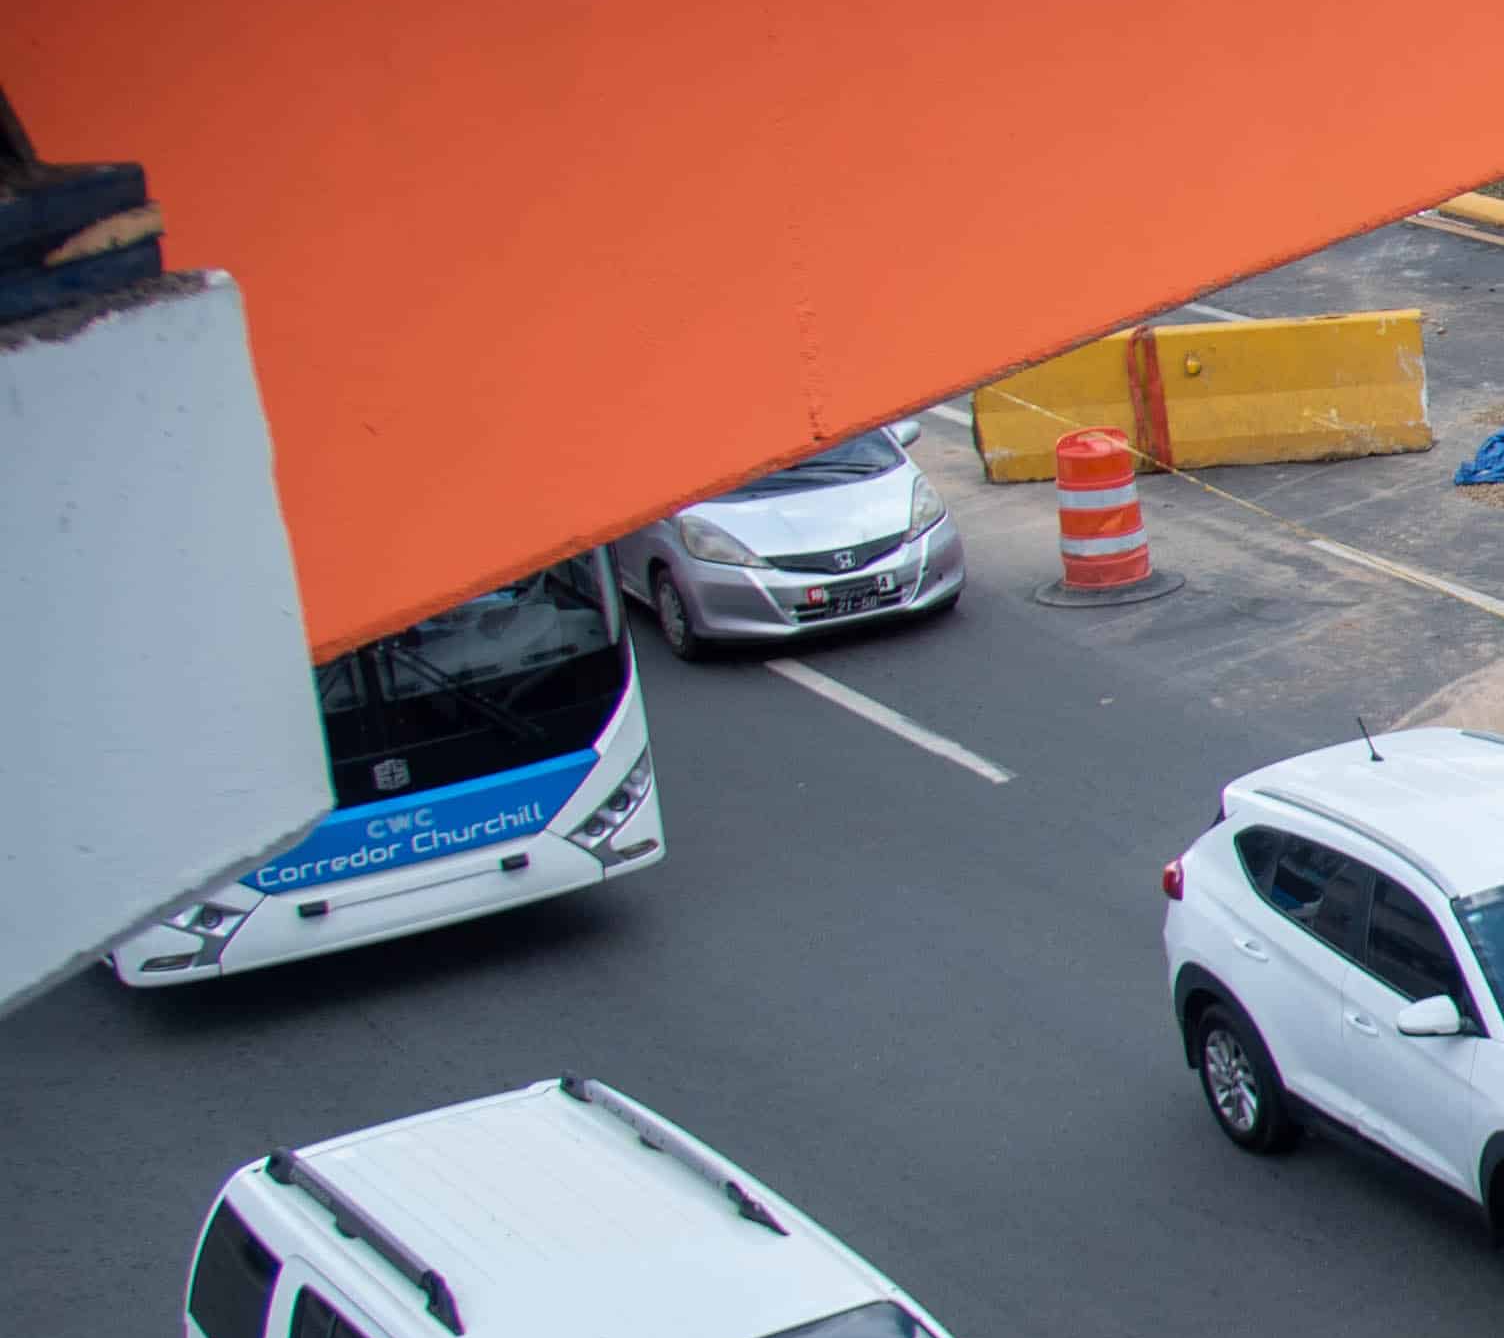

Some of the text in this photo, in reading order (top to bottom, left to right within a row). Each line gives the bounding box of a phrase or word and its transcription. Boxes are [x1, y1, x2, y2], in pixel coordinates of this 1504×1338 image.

[257, 801, 544, 888] Corredor Churchill
[366, 808, 433, 839] CWC
